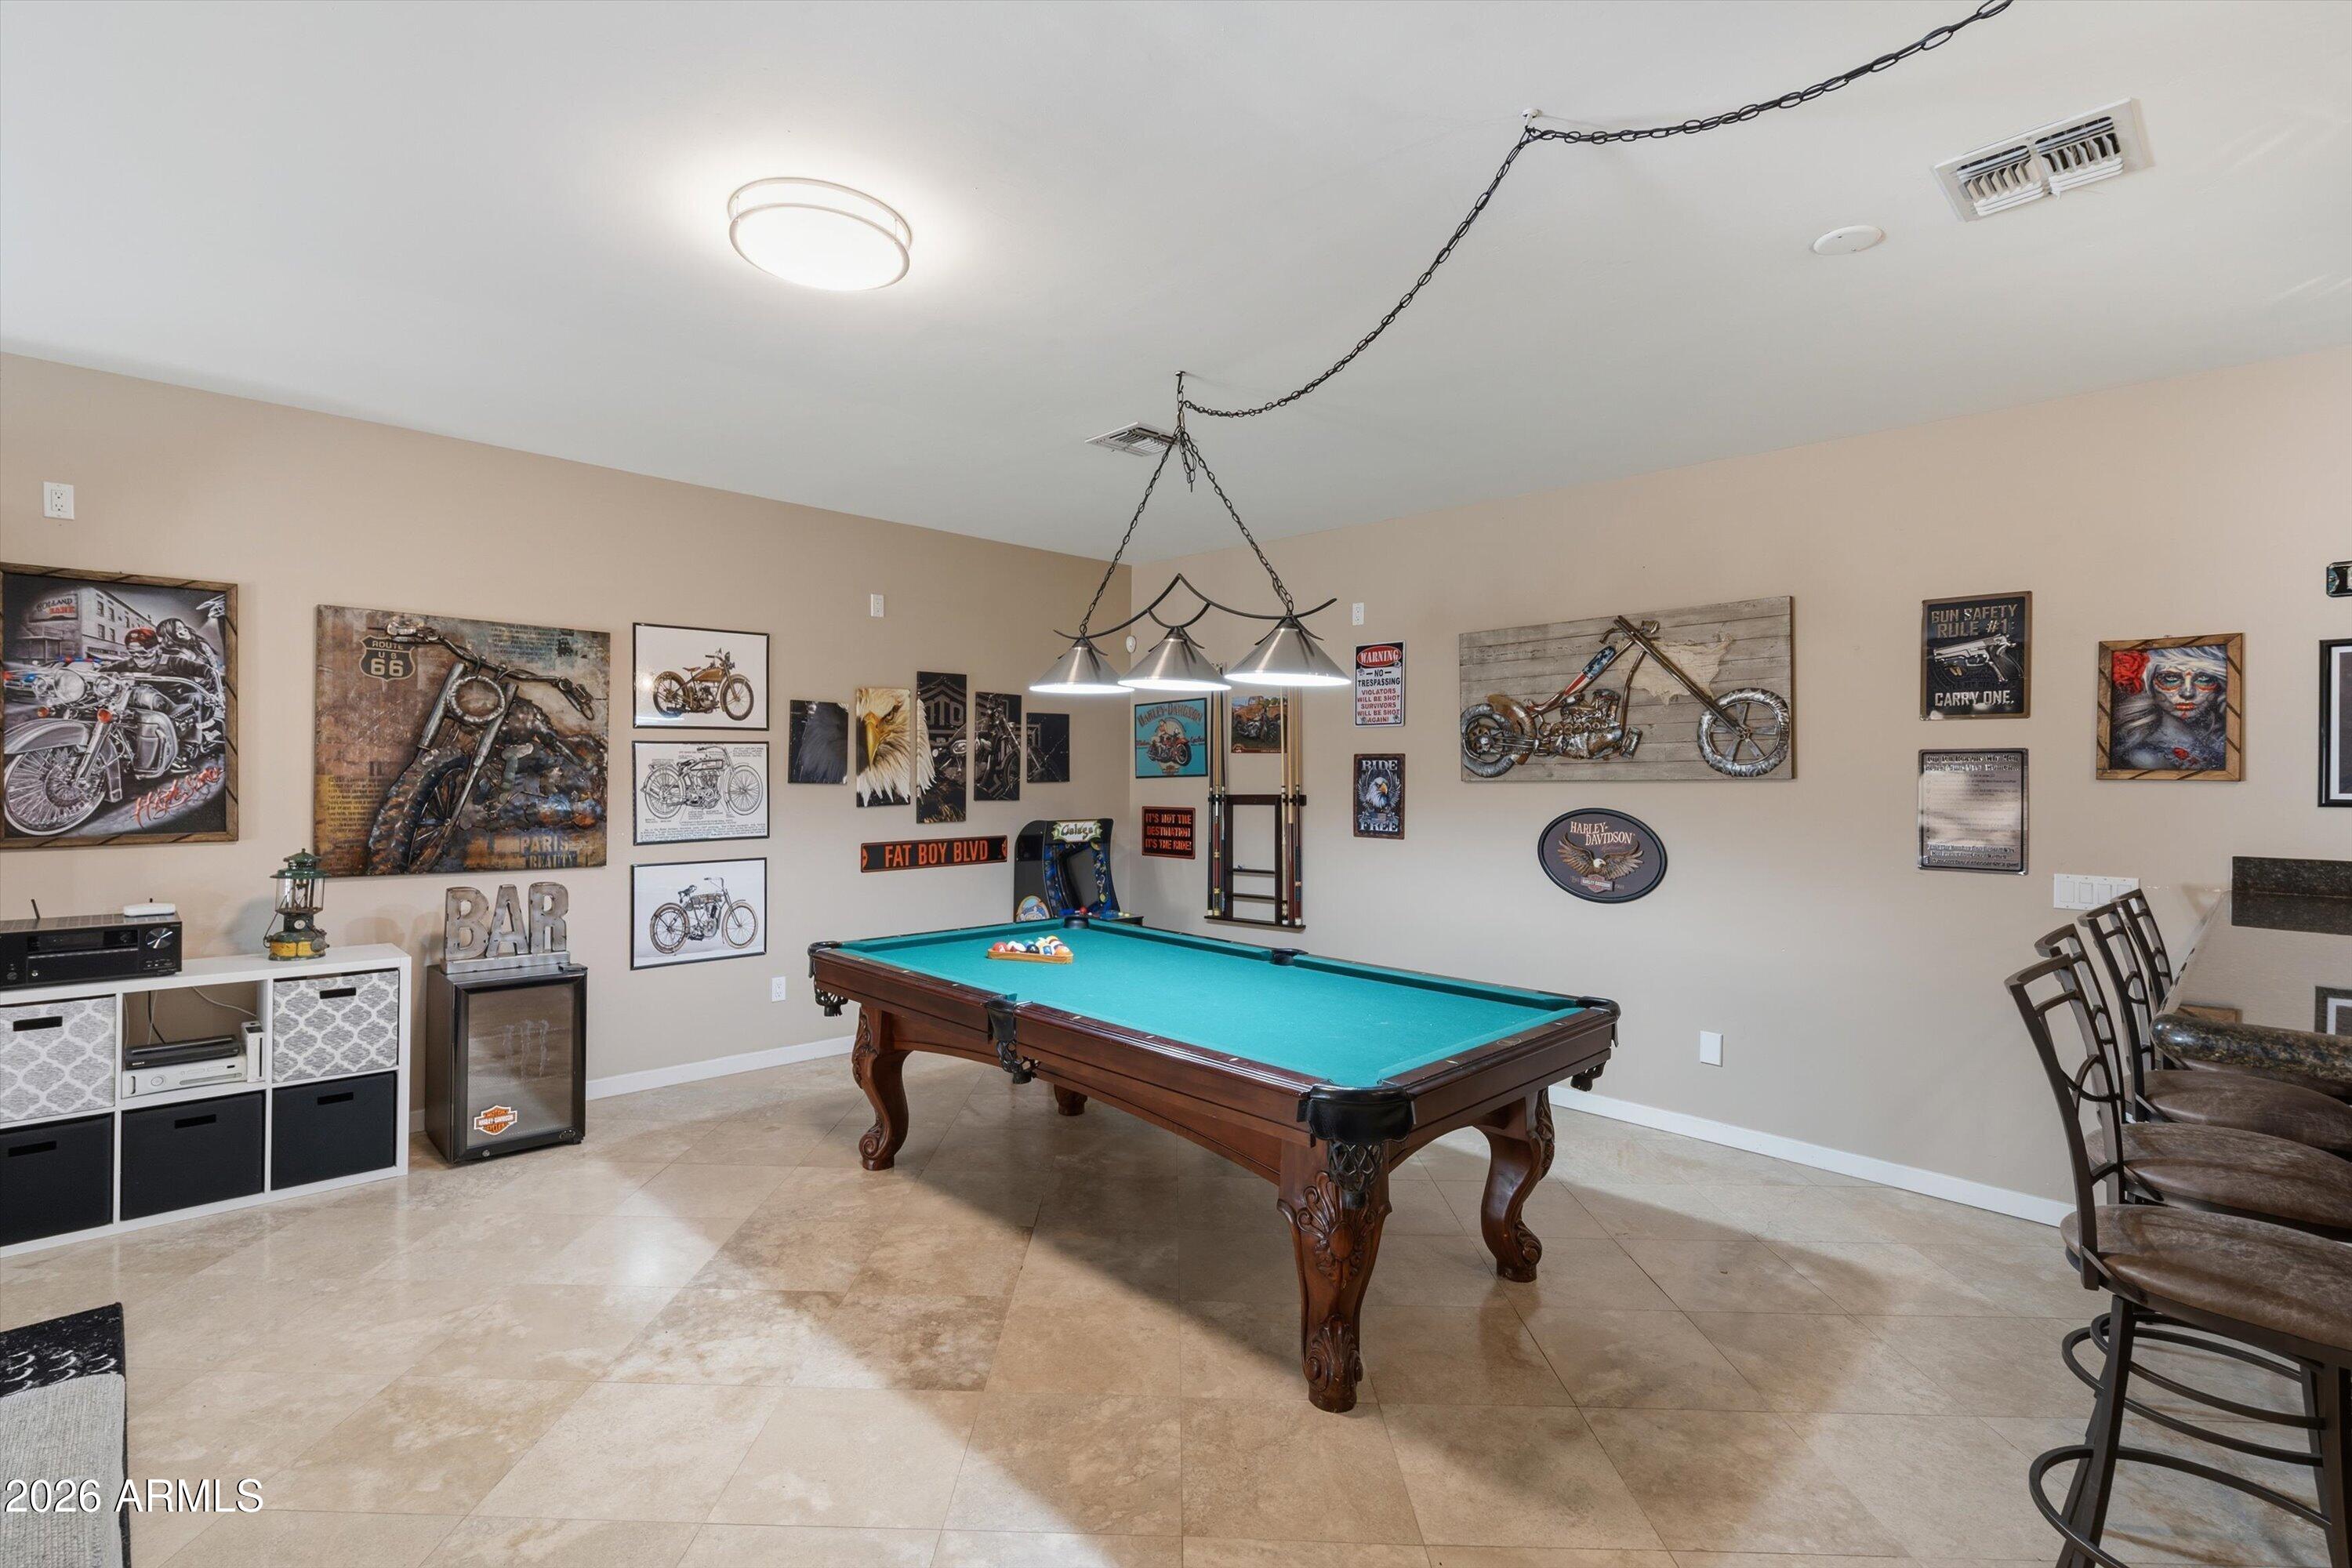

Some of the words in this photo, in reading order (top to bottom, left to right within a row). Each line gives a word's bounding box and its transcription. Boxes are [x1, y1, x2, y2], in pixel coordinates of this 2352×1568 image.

[1931, 608, 1959, 624] GUN
[1964, 604, 2018, 621] SAFETY
[1936, 620, 1979, 638] RULE
[372, 641, 404, 650] ROUTE
[1360, 649, 1399, 663] WARNING
[371, 658, 404, 677] 66
[1357, 677, 1400, 687] TRESPASSING
[1935, 691, 1980, 706] CARRY
[1362, 760, 1398, 771] RIDE
[1145, 813, 1159, 823] IT'S
[1161, 814, 1175, 823] NOT
[1178, 814, 1192, 824] THE
[1359, 822, 1399, 832] FREE
[1570, 821, 1609, 834] HARLEY-
[521, 835, 568, 853] PARIS
[1145, 838, 1157, 849] IT'S
[1159, 839, 1172, 849] THE
[1173, 840, 1192, 851] RIDE!
[1585, 831, 1632, 846] DAVIDSON
[884, 844, 912, 868] FAT
[918, 842, 947, 865] BOY
[953, 840, 988, 862] BLVD
[444, 881, 569, 960] BAR
